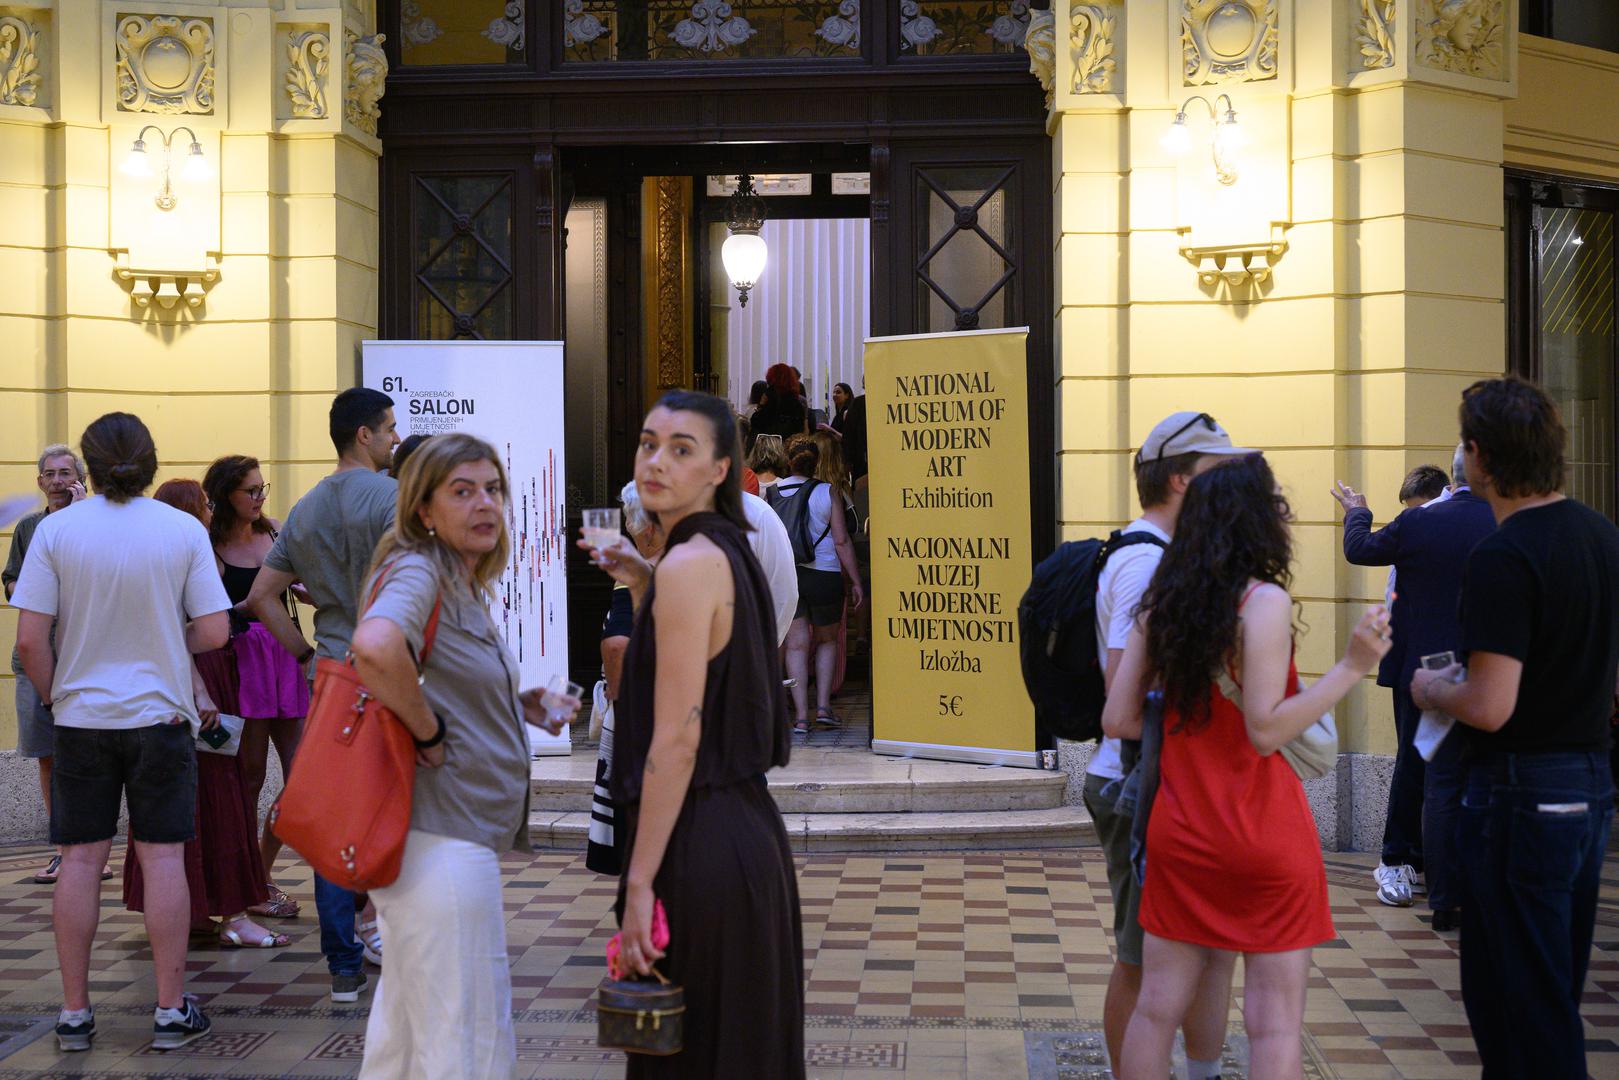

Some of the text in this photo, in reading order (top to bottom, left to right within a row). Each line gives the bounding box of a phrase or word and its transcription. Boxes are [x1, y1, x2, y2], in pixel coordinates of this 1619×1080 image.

[382, 376, 408, 392] 61.
[410, 390, 454, 398] ZAGREBAČKI
[896, 371, 995, 397] NATIONAL
[409, 399, 474, 415] SALON
[886, 398, 1006, 424] MUSEUM OF
[901, 427, 991, 451] MODERN
[926, 455, 967, 478] ART
[902, 486, 993, 509] Exhibition
[887, 537, 1010, 559] NACIONALNI
[917, 564, 981, 590] MUZEJ
[898, 591, 1001, 615] MODERNE
[888, 617, 1014, 643] UMJETNOSTI
[919, 649, 982, 673] Izložba
[939, 695, 963, 717] 5€
